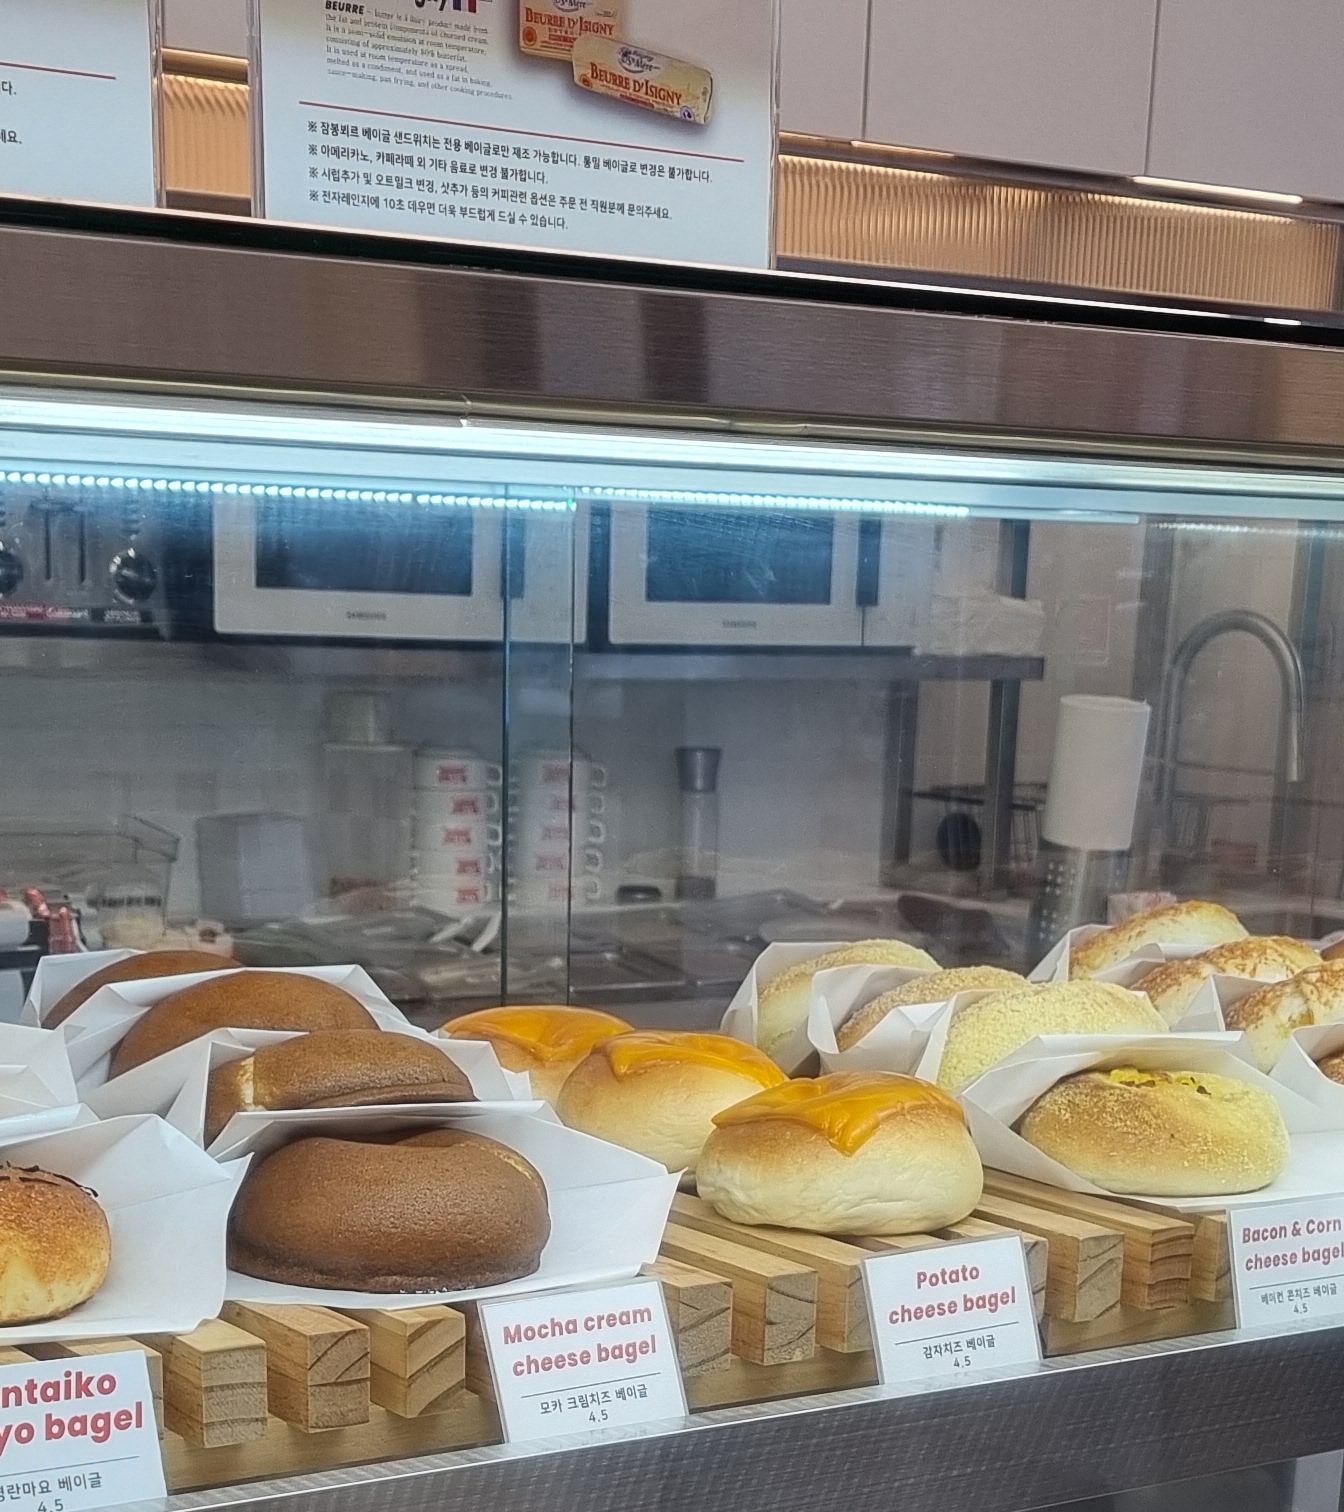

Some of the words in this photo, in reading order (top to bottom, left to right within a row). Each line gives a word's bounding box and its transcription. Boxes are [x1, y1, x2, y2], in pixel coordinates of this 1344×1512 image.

[325, 0, 364, 14] BEURRE
[525, 7, 565, 28] BEURRE
[591, 63, 630, 89] BEURRE
[322, 190, 379, 209] 전자레인지에
[384, 199, 405, 211] 10초
[459, 208, 495, 222] 부드럽게
[519, 213, 528, 224] 수
[530, 214, 568, 230] 있습니다.
[1243, 1226, 1287, 1243] Bacon
[1291, 1221, 1301, 1236] &
[1306, 1219, 1341, 1234] Corn
[1246, 1252, 1297, 1271] cheese
[1302, 1242, 1344, 1265] bagel
[917, 1265, 979, 1289] Potato
[889, 1300, 957, 1324] cheese
[963, 1286, 1015, 1313] bagel
[1294, 1304, 1308, 1314] 4.5
[503, 1317, 577, 1345] Mocha
[584, 1307, 652, 1331] cream
[513, 1350, 591, 1377] cheese
[597, 1335, 657, 1363] bagel
[923, 1341, 963, 1359] 감자치즈
[967, 1335, 995, 1350] 베이글
[954, 1358, 971, 1368] 4.5
[540, 1401, 562, 1414] 모카
[567, 1390, 612, 1410] 크림치즈
[615, 1384, 648, 1400] 베이글
[45, 1402, 142, 1443] bagel
[588, 1410, 608, 1422] 4.5
[58, 1472, 101, 1492] 베이글
[38, 1499, 63, 1512] 4.5
